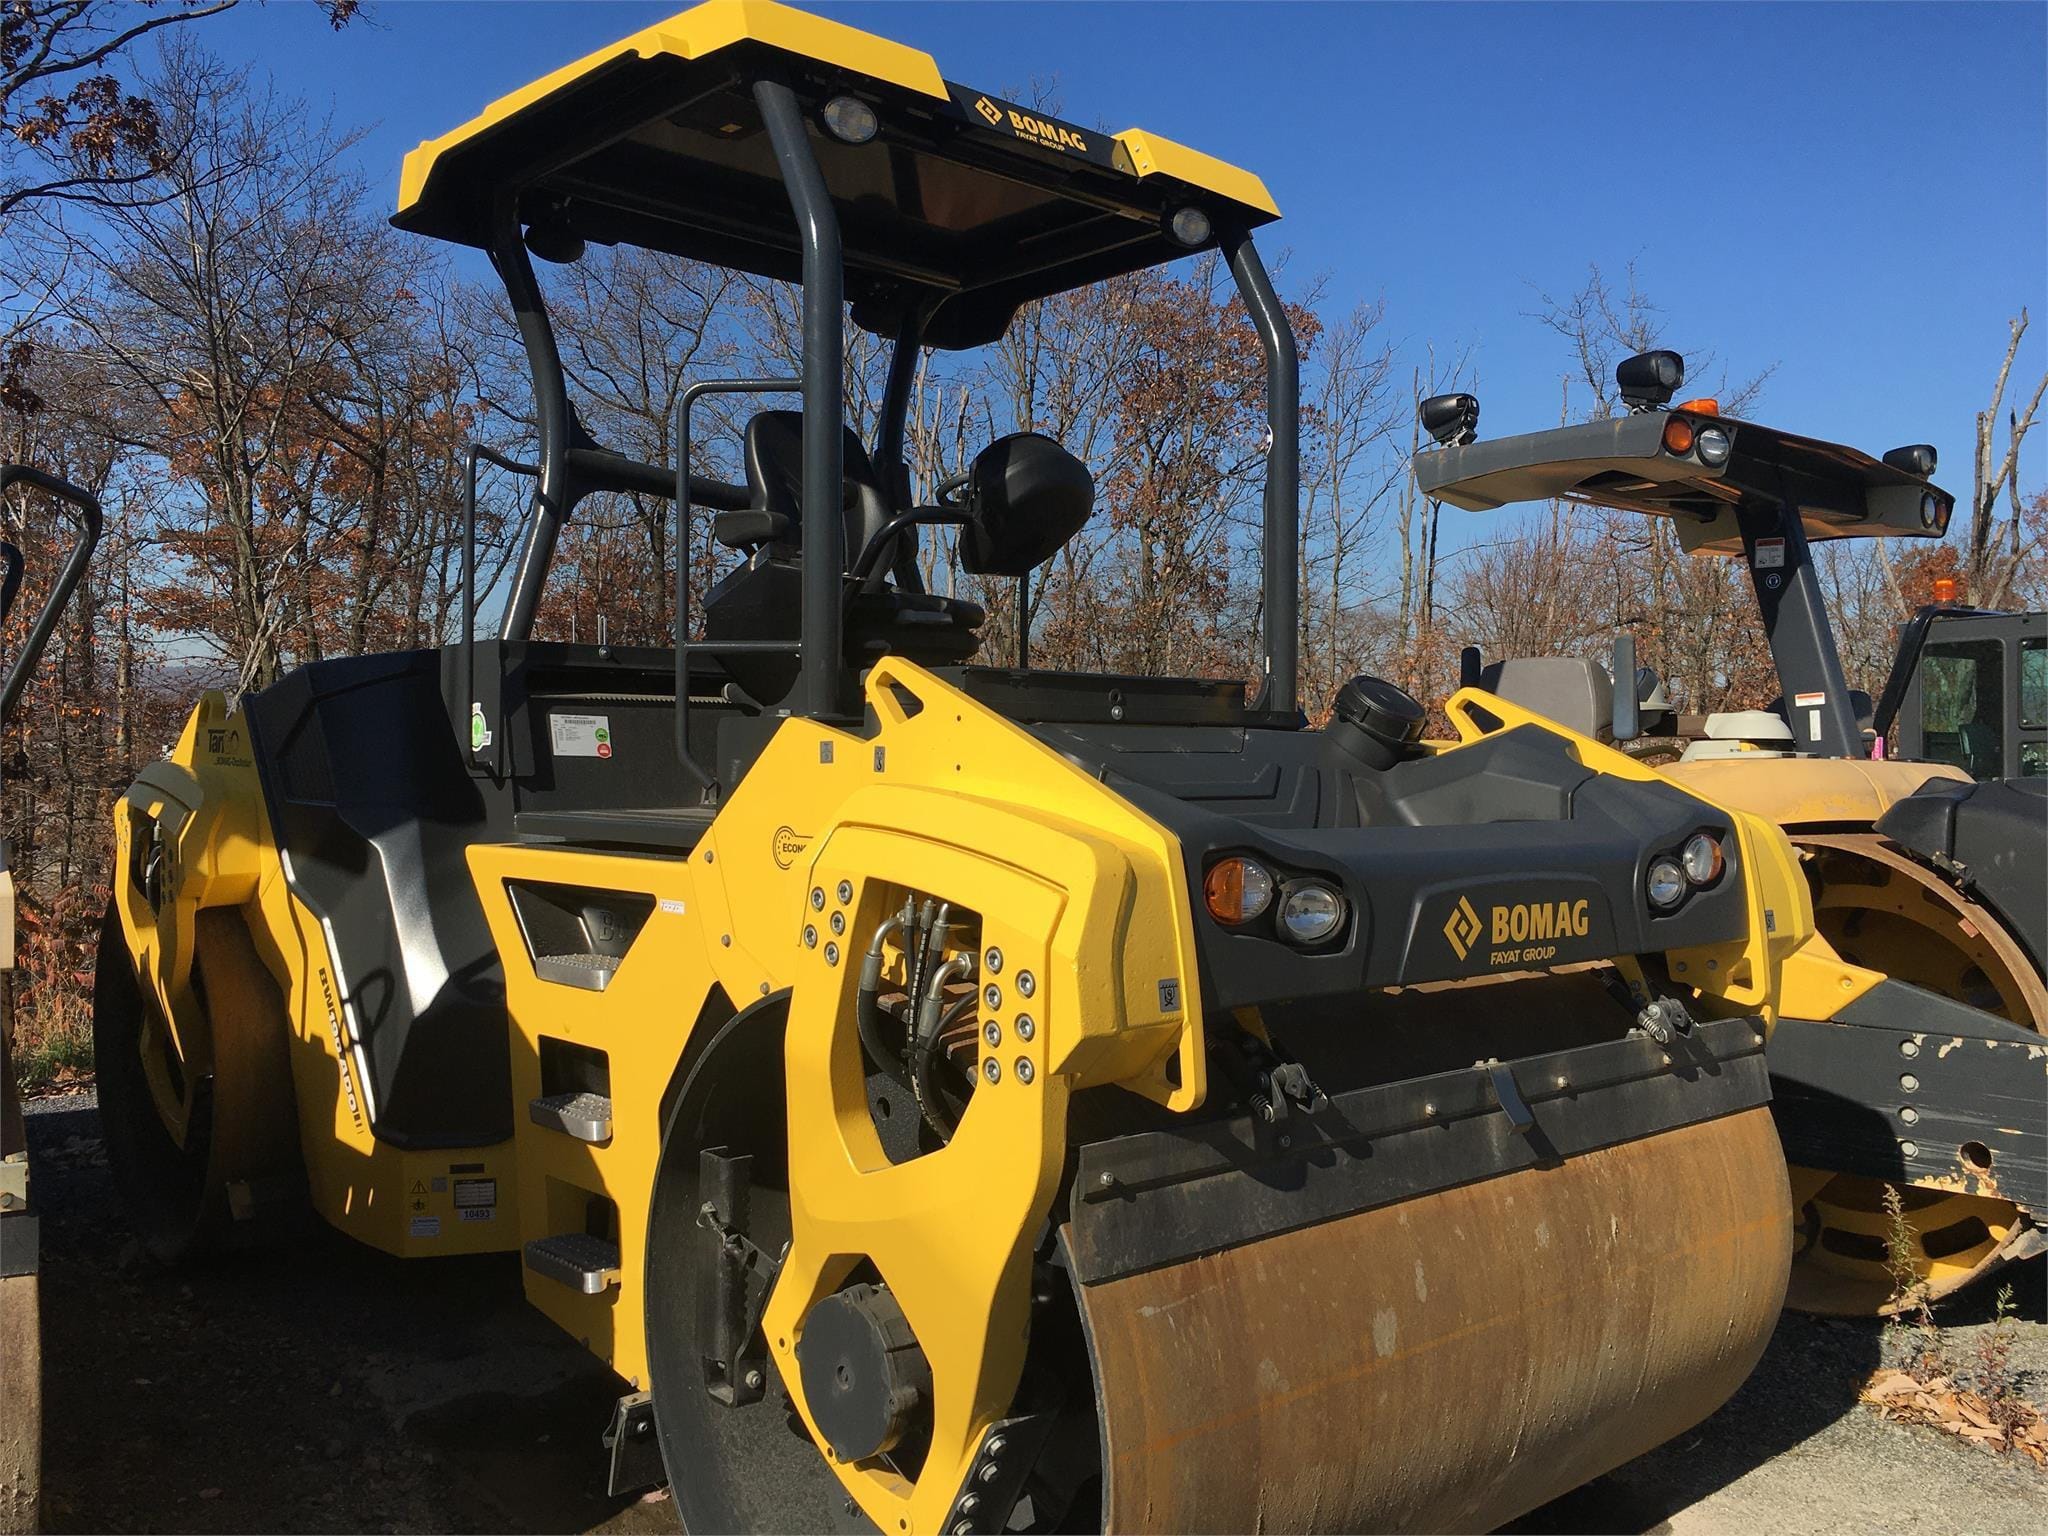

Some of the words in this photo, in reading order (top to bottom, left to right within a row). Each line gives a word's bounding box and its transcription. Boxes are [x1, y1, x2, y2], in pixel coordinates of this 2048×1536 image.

[1008, 110, 1088, 152] BOMAG
[1040, 137, 1066, 151] GROUP
[1491, 899, 1589, 944] BOMAG
[1490, 950, 1521, 965] FAYAT
[1522, 946, 1556, 962] GROUP
[463, 1209, 490, 1219] 10493
